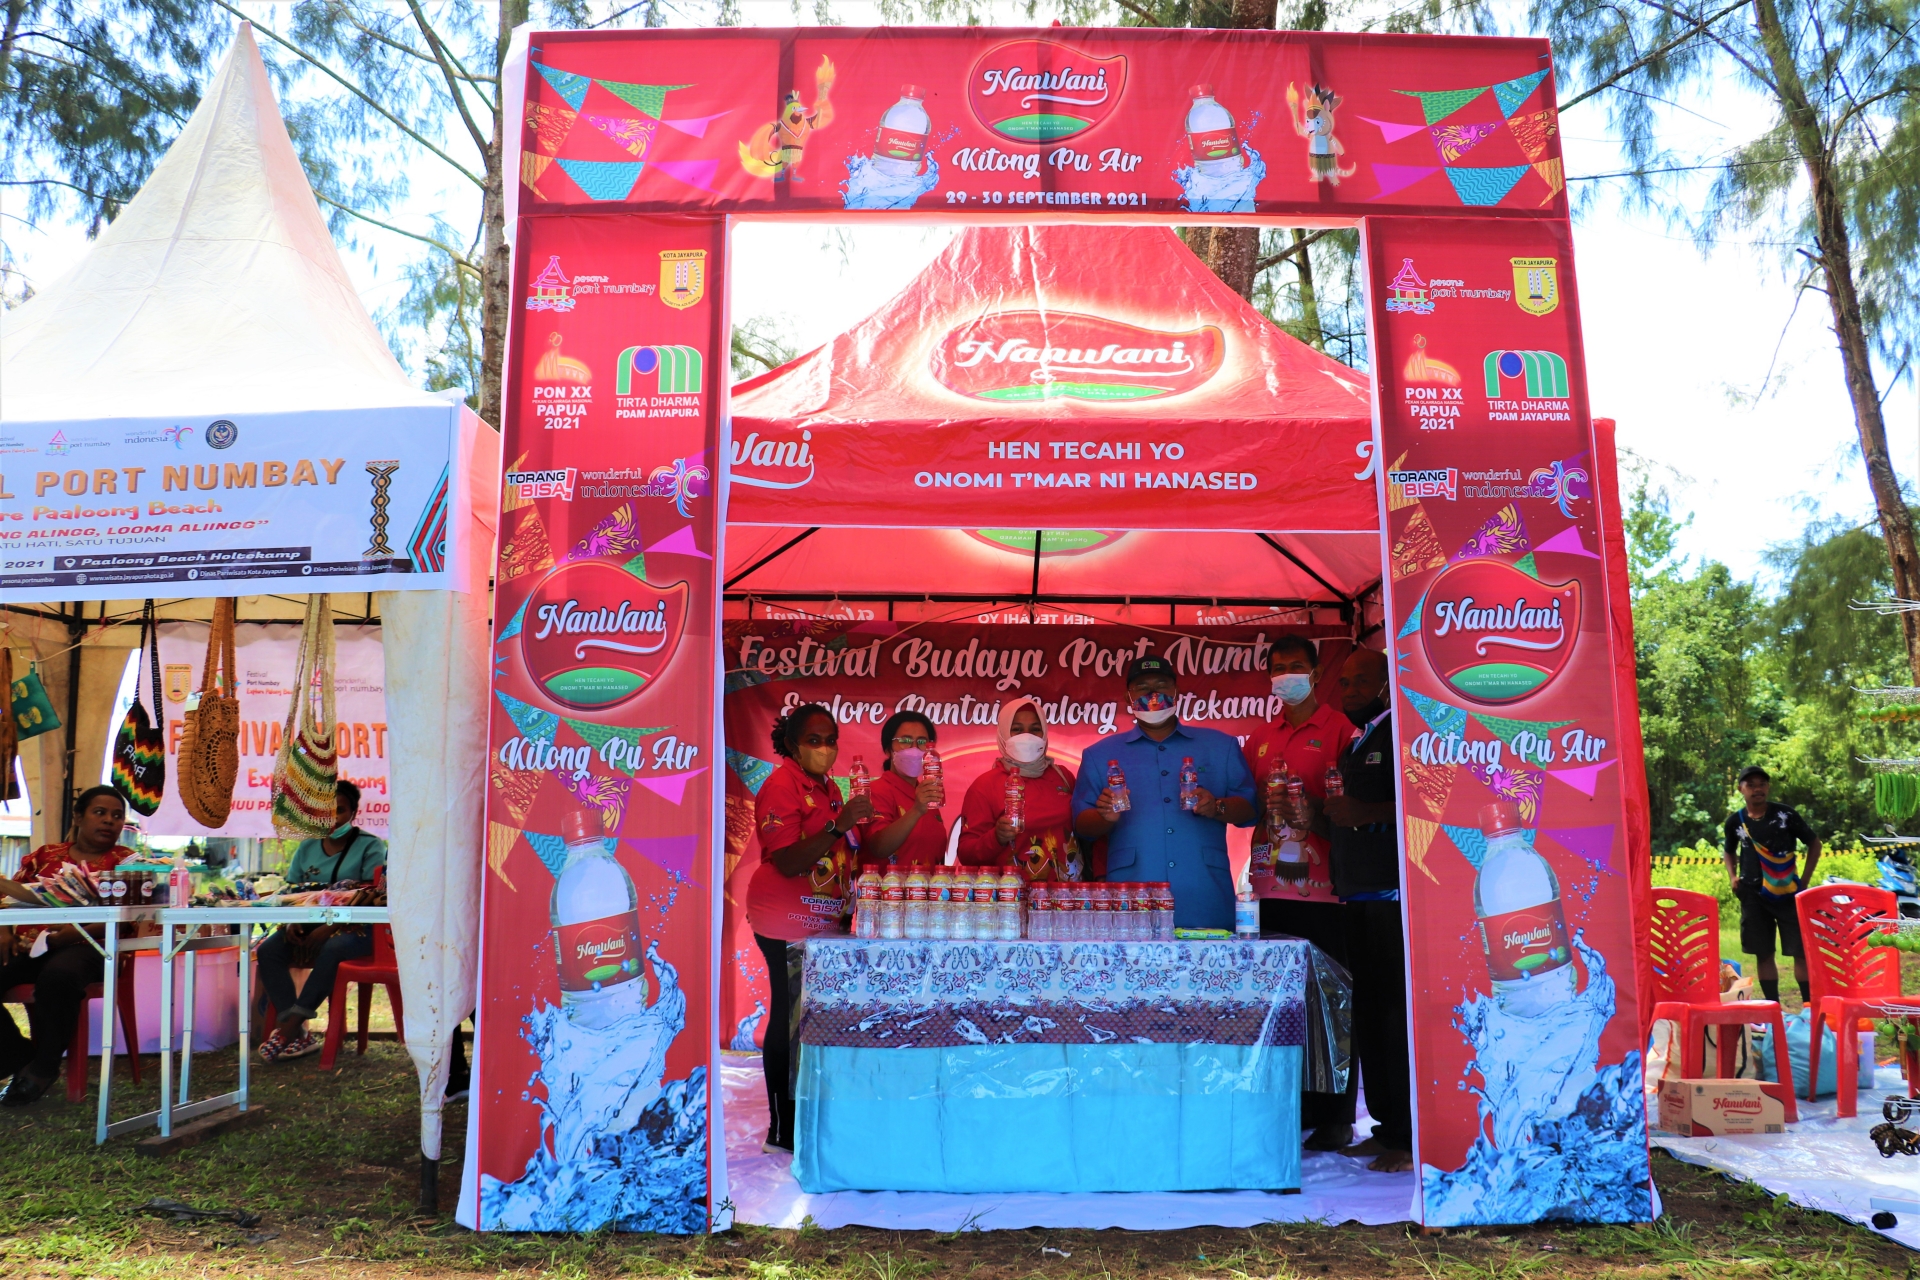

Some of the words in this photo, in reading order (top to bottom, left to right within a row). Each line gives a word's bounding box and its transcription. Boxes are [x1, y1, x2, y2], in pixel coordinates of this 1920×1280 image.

[951, 146, 1040, 180] Kitong
[1048, 146, 1093, 173] Pu
[1098, 147, 1143, 173] Air
[982, 190, 1002, 205] 30
[1007, 190, 1102, 206] SEPTEMBER
[1106, 191, 1148, 206] 2021
[572, 282, 600, 297] port
[1430, 287, 1457, 300] port
[534, 386, 566, 398] PON
[570, 386, 592, 398] XX
[1405, 387, 1438, 400] PON
[1441, 388, 1464, 400] XX
[616, 397, 648, 408] TIRTA
[650, 396, 700, 408] DHARMA
[1488, 400, 1519, 411] TIRTA
[1520, 401, 1570, 411] DHARMA
[536, 404, 588, 416] PAPUA
[616, 408, 646, 419] PDAM
[648, 408, 700, 418] JAYAPURA
[1410, 404, 1461, 417] PAPUA
[544, 416, 580, 430] 2021
[1488, 412, 1518, 421] PDAM
[1520, 412, 1571, 422] JAYAPURA
[1420, 418, 1455, 430] 2021
[124, 436, 168, 444] indonesia
[988, 441, 1040, 460] HEN
[1048, 441, 1141, 460] TECAHI
[1149, 442, 1185, 461] YO
[36, 467, 146, 497] PORT
[162, 458, 347, 492] NUMBAY
[508, 471, 566, 484] TORANG
[581, 468, 642, 480] wonderful
[1389, 471, 1448, 484] TORANG
[1462, 469, 1523, 481] wonderful
[914, 471, 1003, 488] ONOMI
[1100, 472, 1126, 488] NI
[1134, 472, 1258, 491] HANASED
[580, 481, 664, 498] indonesia
[1463, 481, 1546, 498] indonesia
[32, 504, 140, 522] Paaloong
[148, 498, 223, 516] Beach
[106, 524, 173, 536] LOOMA
[26, 540, 62, 548] HATI,
[66, 538, 103, 547] SATU
[109, 536, 166, 546] TUJUAN
[4, 560, 45, 569] 2021
[81, 556, 154, 568] Paaloong
[157, 552, 207, 564] Beach
[210, 550, 301, 562] Holtekamp
[200, 570, 216, 578] Dinas
[216, 568, 246, 577] Pariwisata
[247, 568, 262, 576] Kota
[330, 564, 358, 572] Pariwisata
[357, 564, 370, 572] Kota
[738, 635, 883, 678] Festival
[892, 637, 1048, 691] Budaya
[1059, 636, 1155, 678] Port
[336, 721, 388, 759] ORT
[499, 736, 591, 782] Kitong
[600, 736, 645, 771] Pu
[652, 735, 699, 770] Air
[1411, 730, 1503, 776] Kitong
[1510, 730, 1556, 764] Pu
[1561, 729, 1607, 763] Air
[802, 896, 842, 906] TORANG
[788, 913, 808, 921] PON
